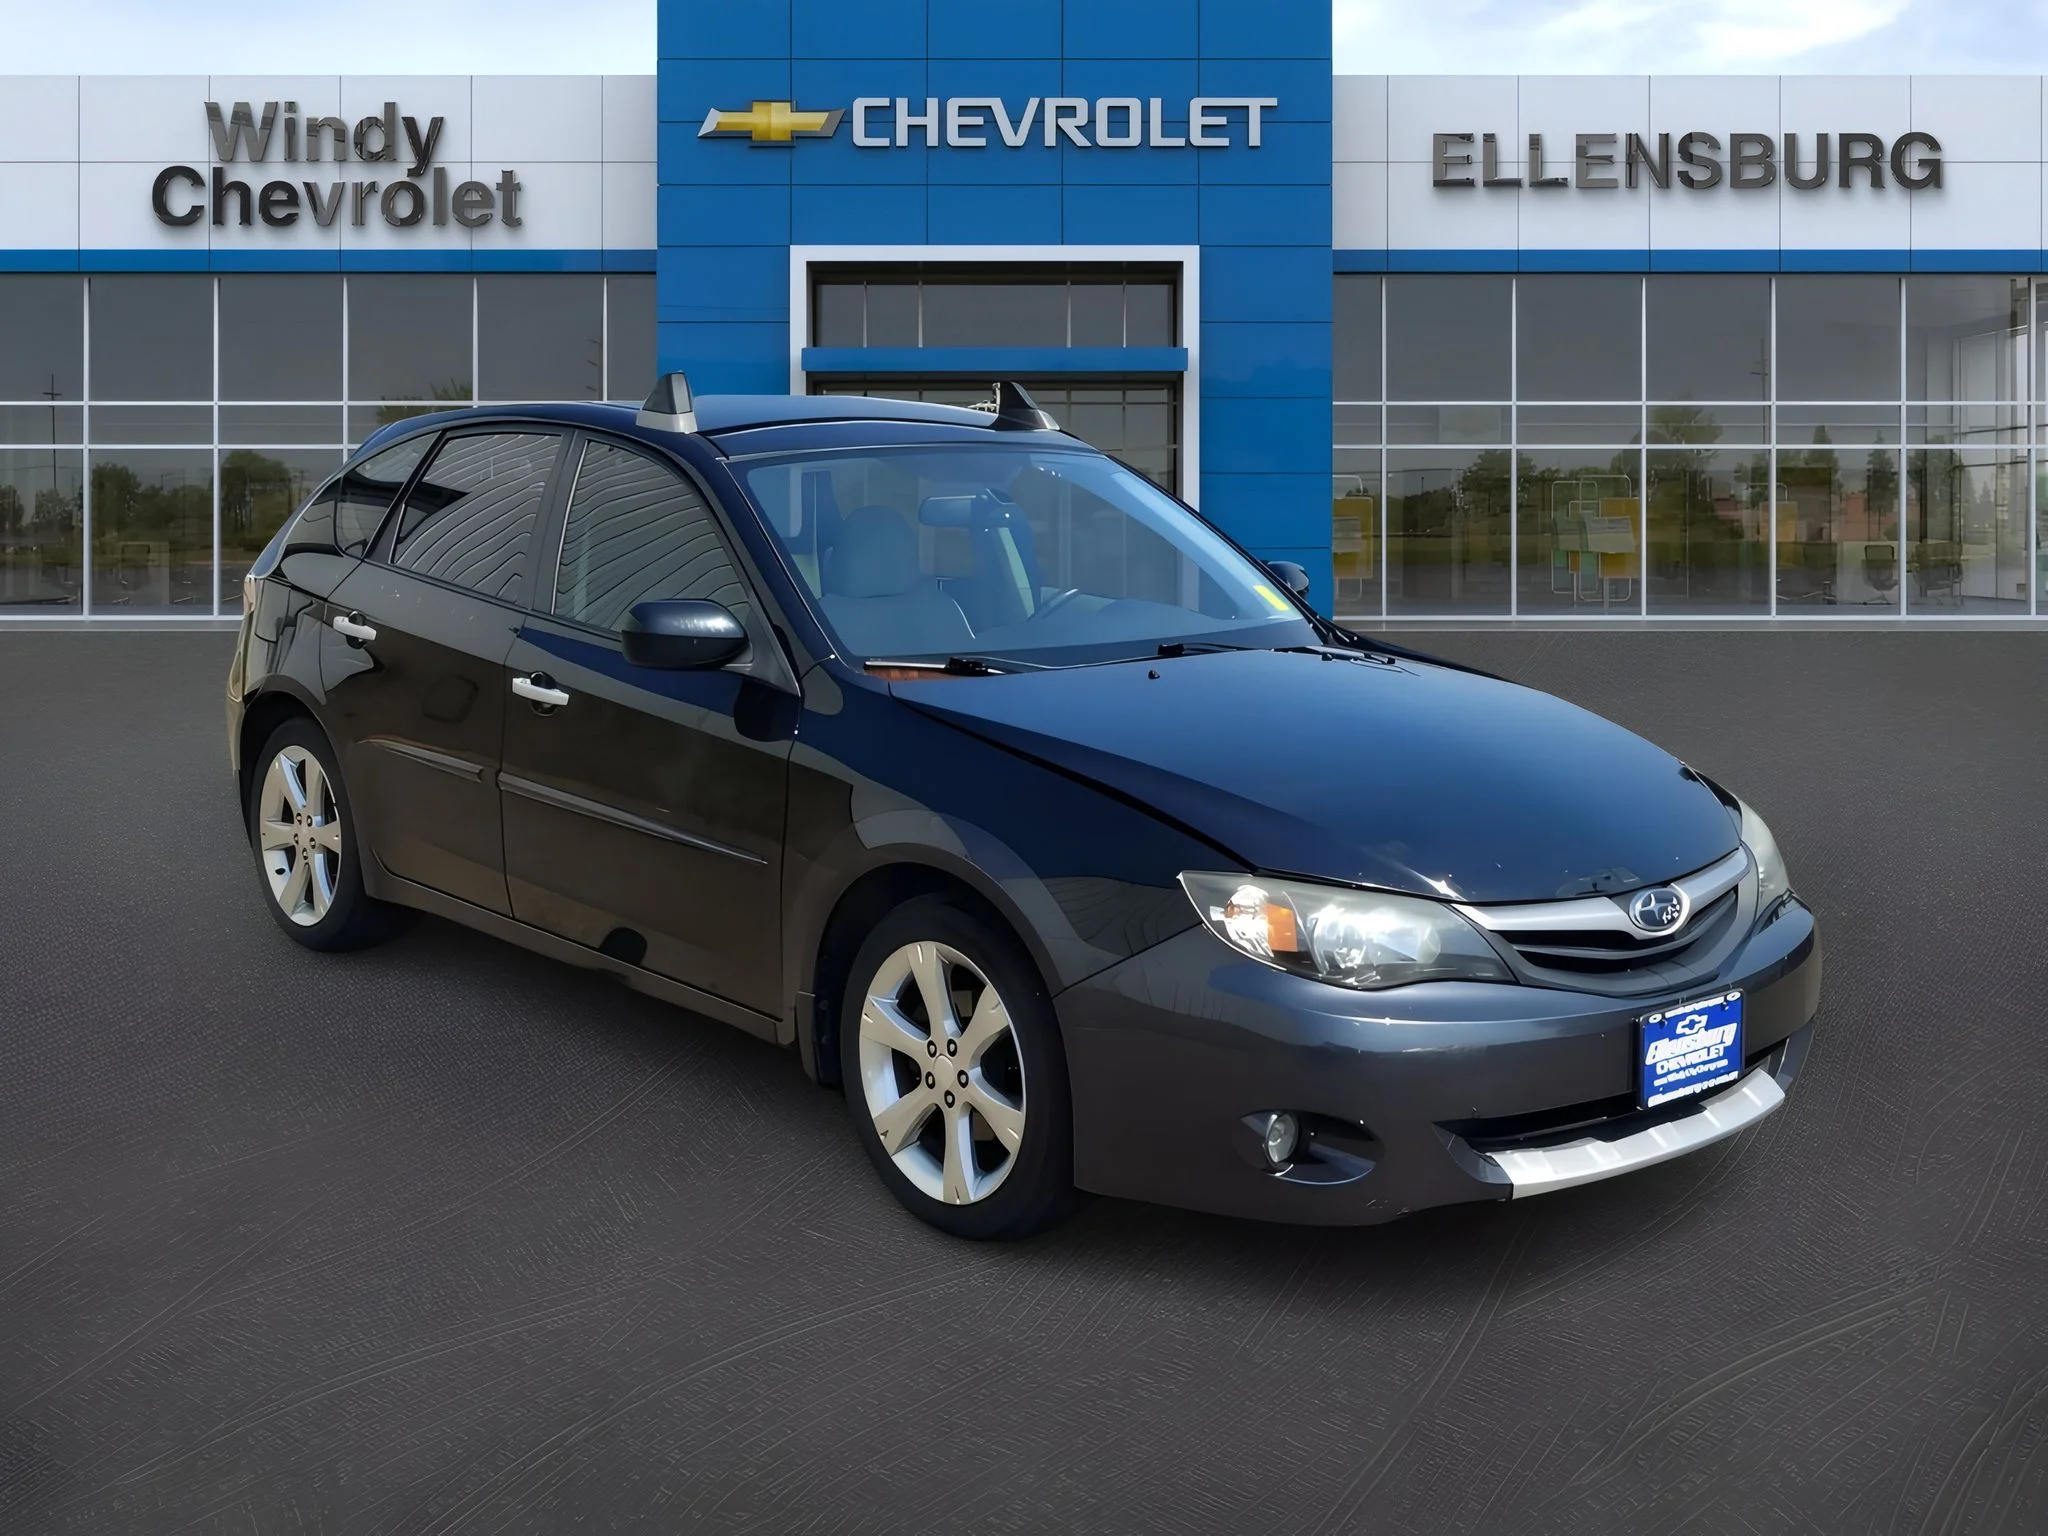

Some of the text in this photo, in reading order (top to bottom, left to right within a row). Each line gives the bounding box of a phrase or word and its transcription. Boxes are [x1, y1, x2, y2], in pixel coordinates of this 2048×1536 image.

[204, 101, 445, 177] Windy
[852, 97, 1278, 148] CHEVROLET
[1432, 131, 1944, 190] ELLENSBURG
[151, 165, 523, 228] Chevrolet
